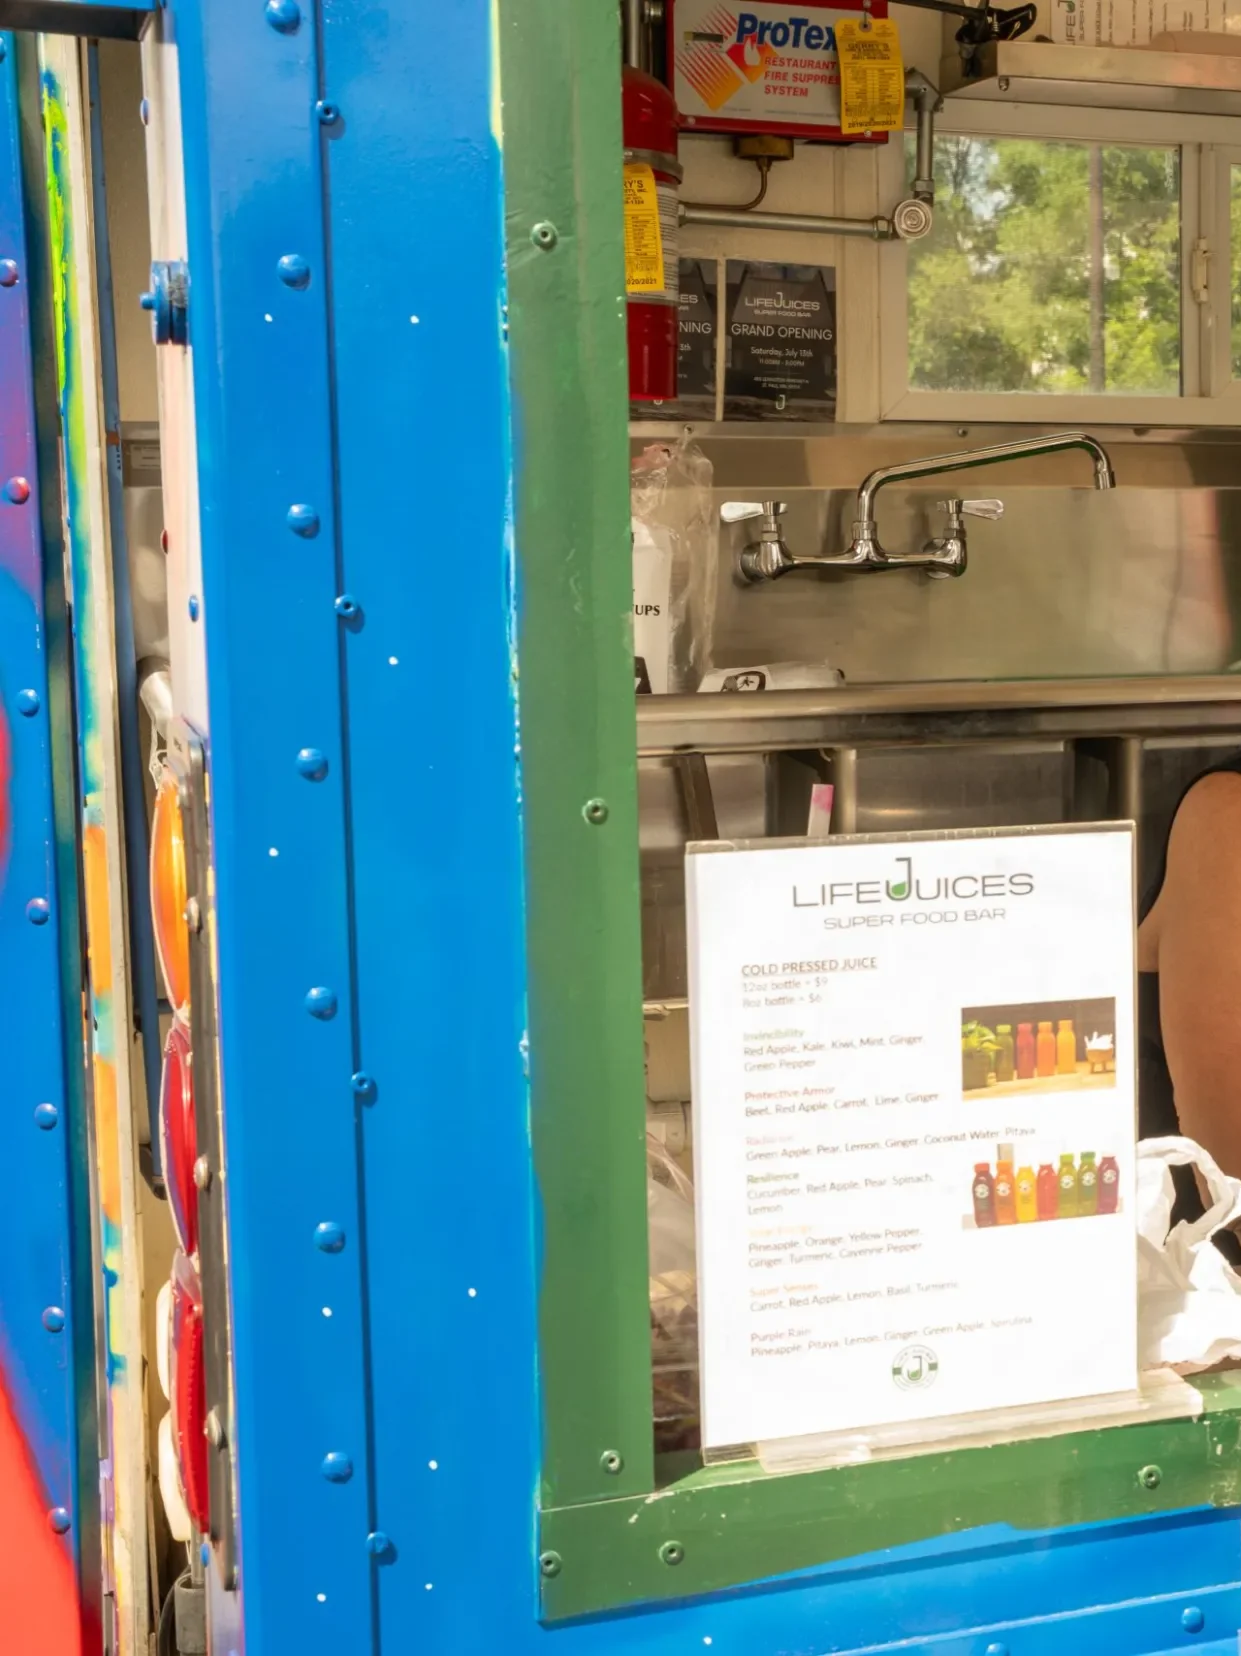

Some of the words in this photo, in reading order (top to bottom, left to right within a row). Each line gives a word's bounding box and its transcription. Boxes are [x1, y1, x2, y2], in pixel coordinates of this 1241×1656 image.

[736, 13, 837, 51] ProTex
[764, 57, 836, 70] RESTAURANT
[764, 70, 789, 81] FIRE
[764, 85, 808, 97] SYSTEM
[745, 292, 820, 311] LIFEJUICES
[731, 323, 775, 337] GRAND
[778, 326, 833, 340] OPENING
[751, 346, 783, 357] Saturday,
[785, 348, 798, 358] July
[633, 604, 661, 616] UPS
[792, 857, 1035, 908] LIFEJUICES
[824, 914, 894, 930] SUPER
[900, 911, 958, 926] FOOD
[964, 908, 1006, 923] BAR
[741, 963, 778, 977] COLD
[782, 959, 838, 974] PRESSED
[842, 957, 877, 971] JUICE
[771, 978, 802, 990] bottle
[764, 995, 796, 1006] bottle
[743, 1046, 763, 1057] Red
[779, 1059, 816, 1070] Pepper
[744, 1088, 799, 1102] Protective
[802, 1086, 835, 1097] Armor
[775, 1104, 796, 1114] Red
[905, 1093, 940, 1104] Ginger
[745, 1150, 778, 1161] Green
[923, 1133, 967, 1145] Coconut
[746, 1172, 800, 1186] Resilience
[806, 1183, 828, 1194] Red
[747, 1204, 783, 1216] Lemon
[848, 1231, 883, 1242] Yellow
[886, 1243, 922, 1253] Pepper
[788, 1297, 810, 1307] Red
[922, 1326, 953, 1336] Green
